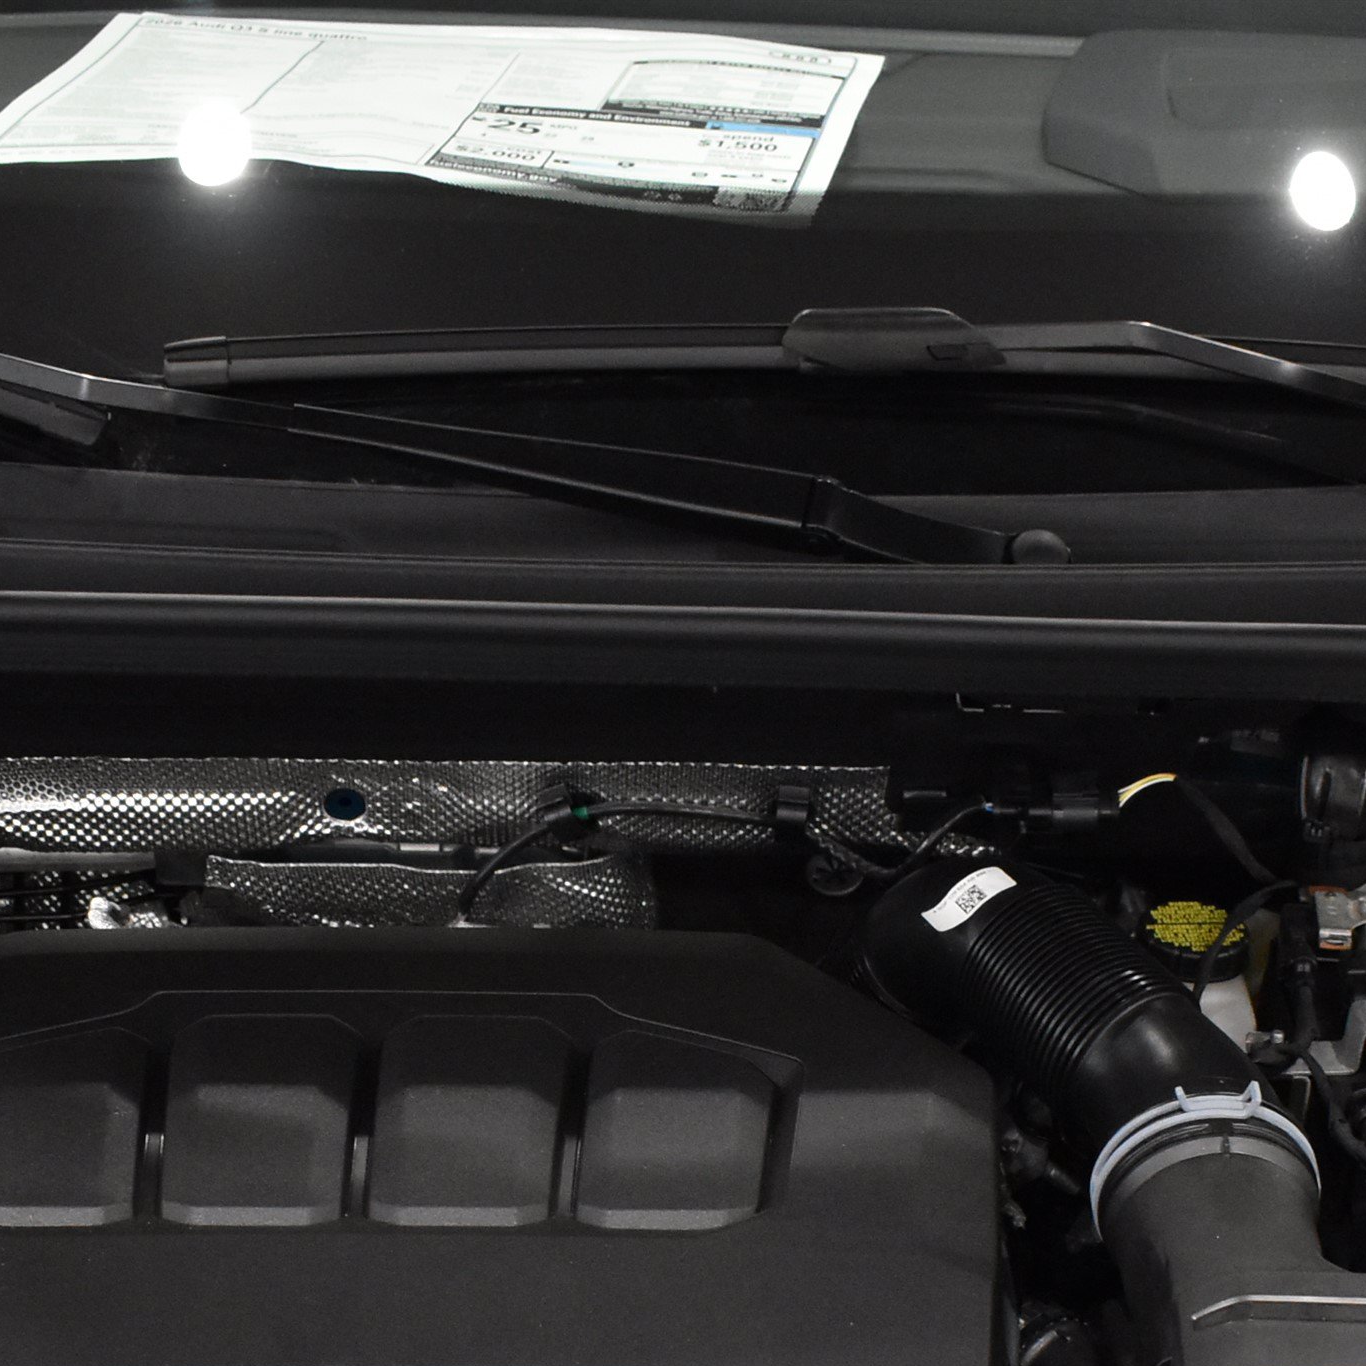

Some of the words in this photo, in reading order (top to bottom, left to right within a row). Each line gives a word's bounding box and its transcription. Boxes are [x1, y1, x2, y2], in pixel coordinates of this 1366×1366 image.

[188, 20, 226, 29] Audi
[273, 28, 304, 36] line
[308, 32, 369, 42] quattro
[503, 106, 530, 115] Fuel
[531, 107, 587, 119] Economy
[588, 111, 611, 121] and
[613, 114, 691, 127] Environment
[487, 118, 543, 135] 25
[698, 138, 778, 152] $1,500
[723, 134, 775, 143] spend
[429, 160, 558, 182] fueleconomy.gov
